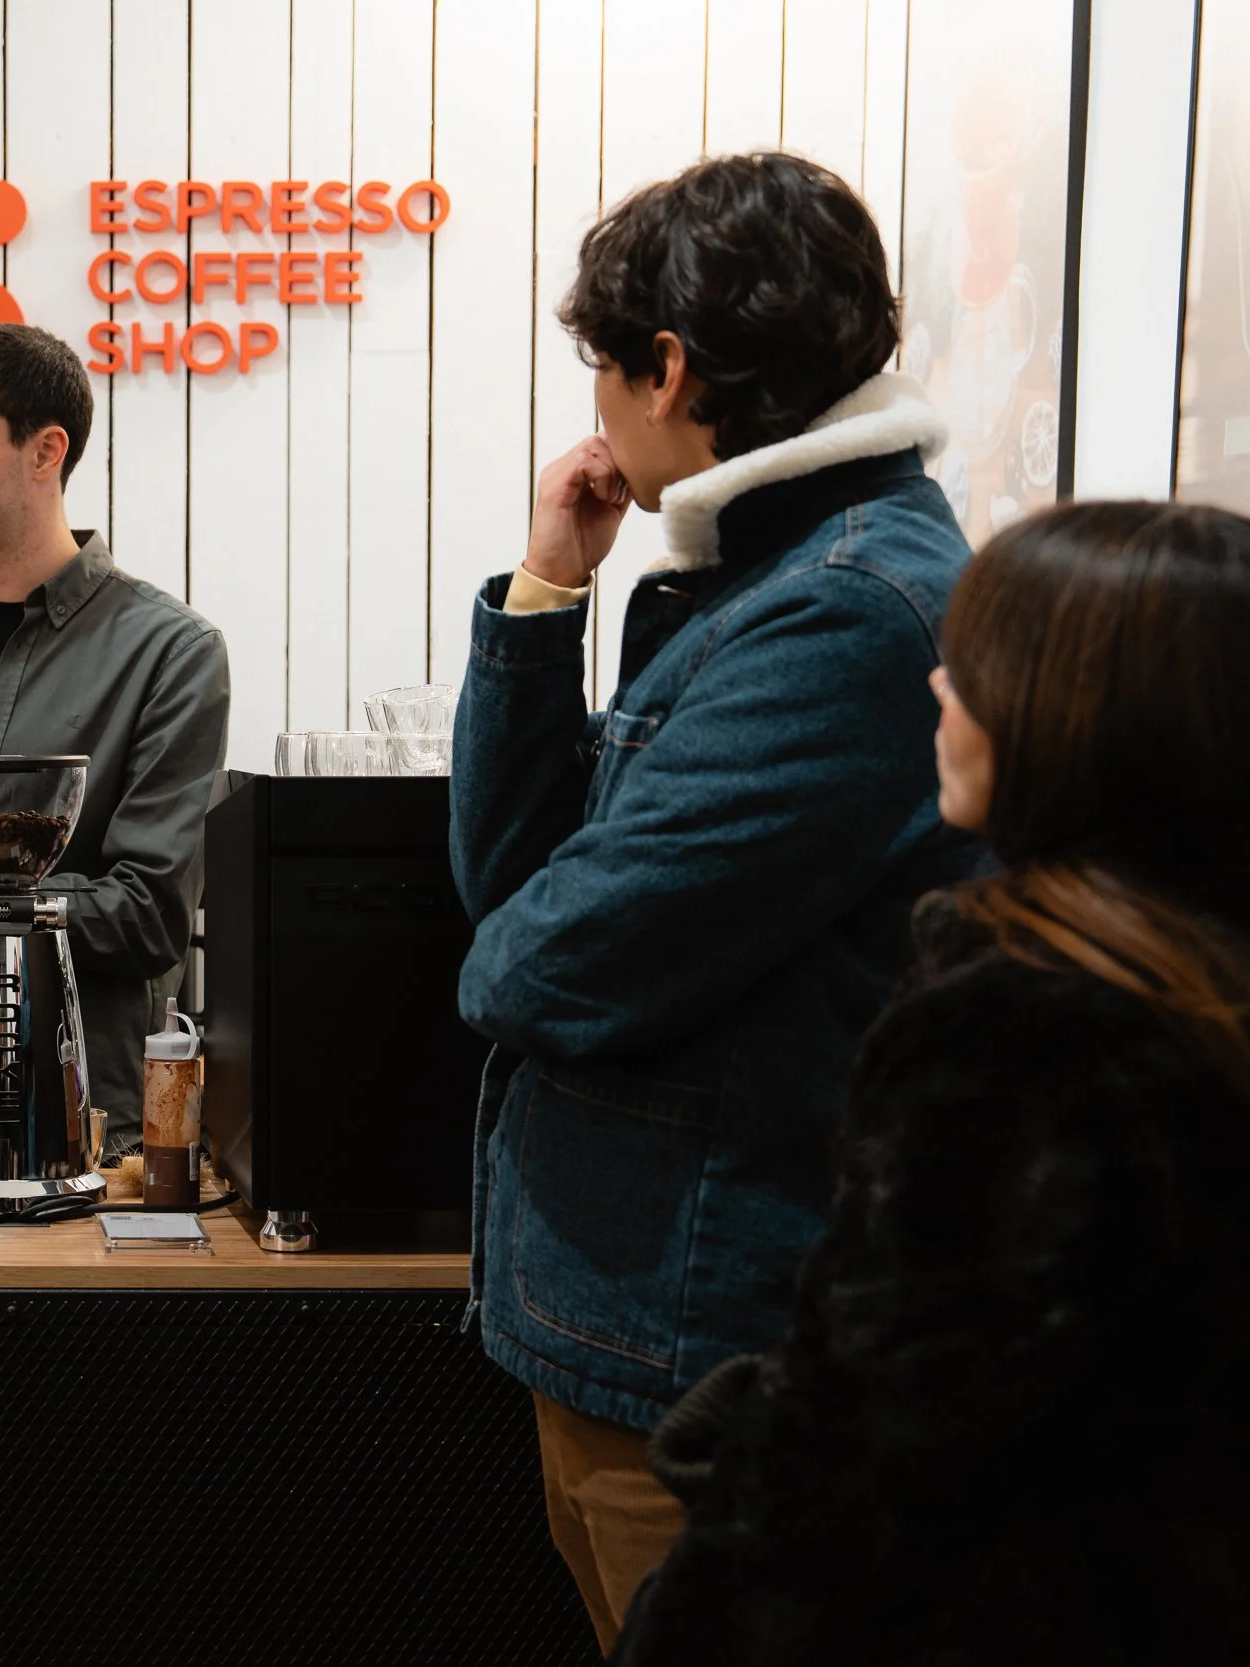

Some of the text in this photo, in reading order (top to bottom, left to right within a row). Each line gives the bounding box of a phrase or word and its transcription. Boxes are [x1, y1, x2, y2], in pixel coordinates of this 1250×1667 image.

[89, 179, 450, 235] ESPRESSO
[87, 249, 362, 304] COFFEE
[87, 320, 279, 374] SHOP
